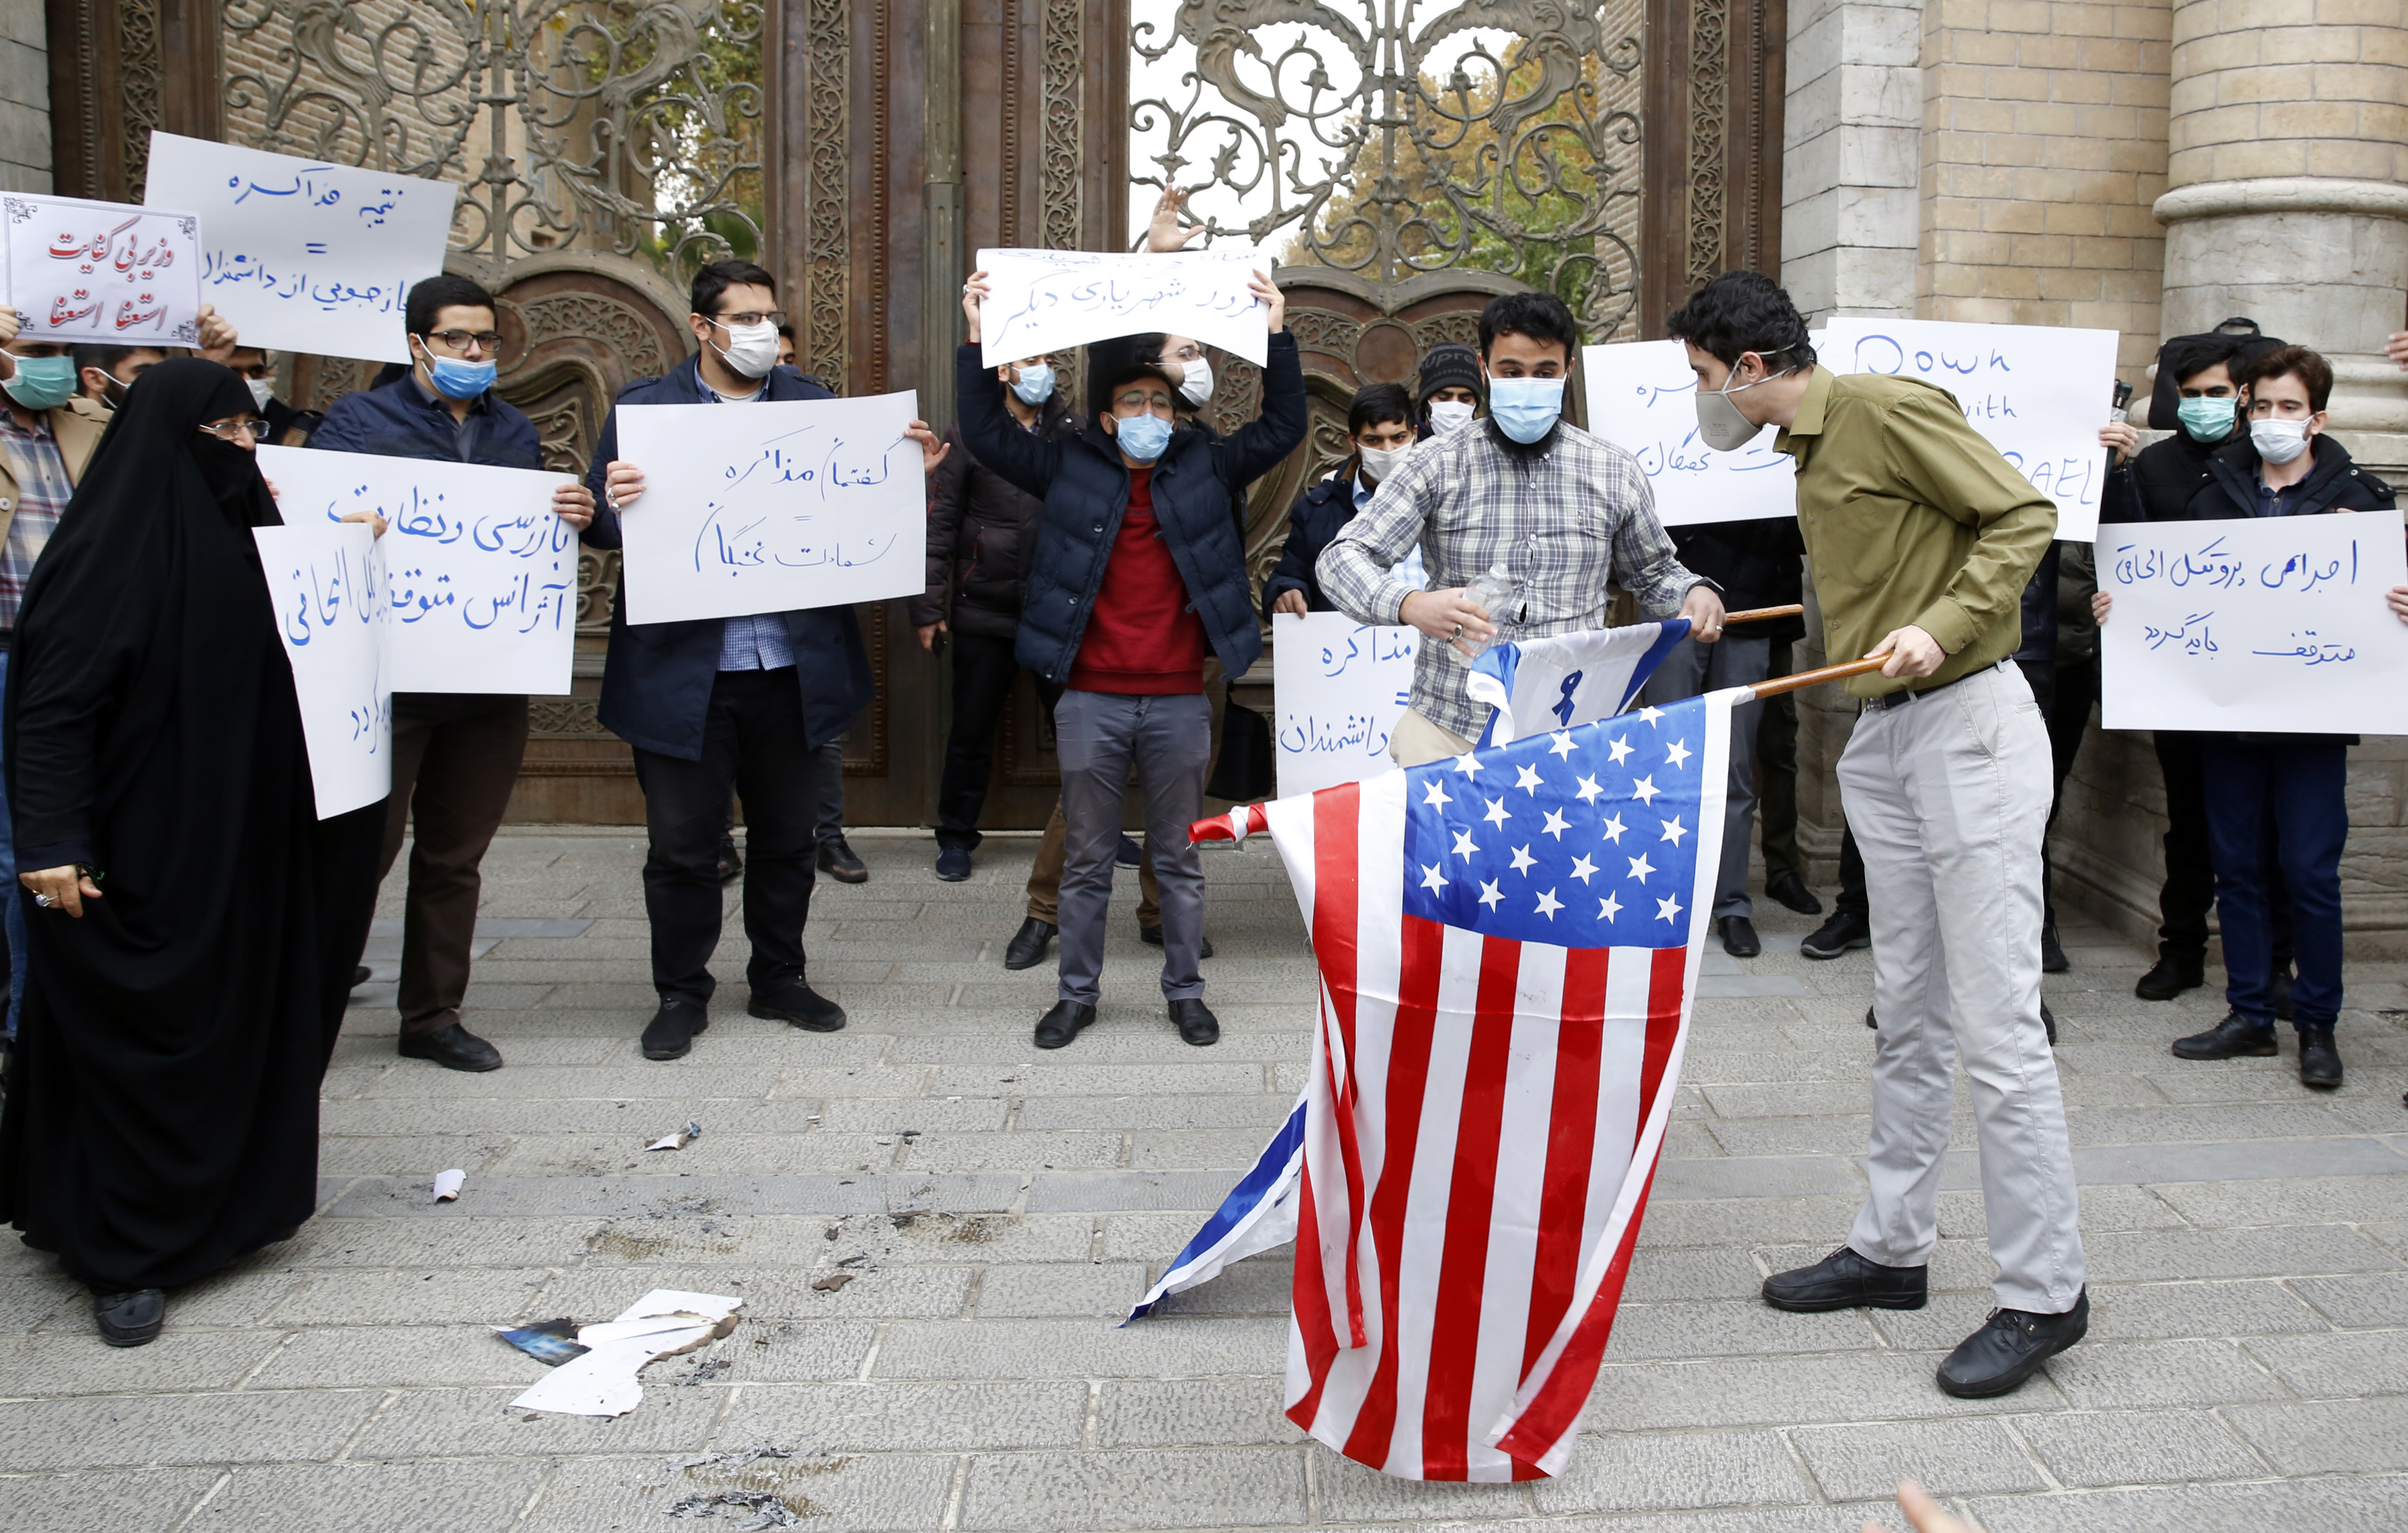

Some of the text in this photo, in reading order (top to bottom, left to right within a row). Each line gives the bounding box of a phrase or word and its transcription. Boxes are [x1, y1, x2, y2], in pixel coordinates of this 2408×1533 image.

[228, 167, 341, 207] مذاکره
[49, 215, 174, 282] وزیر بی کفایت
[50, 288, 168, 330] استعفا استعفا
[277, 274, 306, 299] از
[725, 425, 815, 491] مذاکره
[2002, 451, 2094, 505] AEL
[463, 572, 574, 634] آژانس
[1322, 625, 1412, 677] مذاکره
[1280, 713, 1389, 757] دانشمندان
